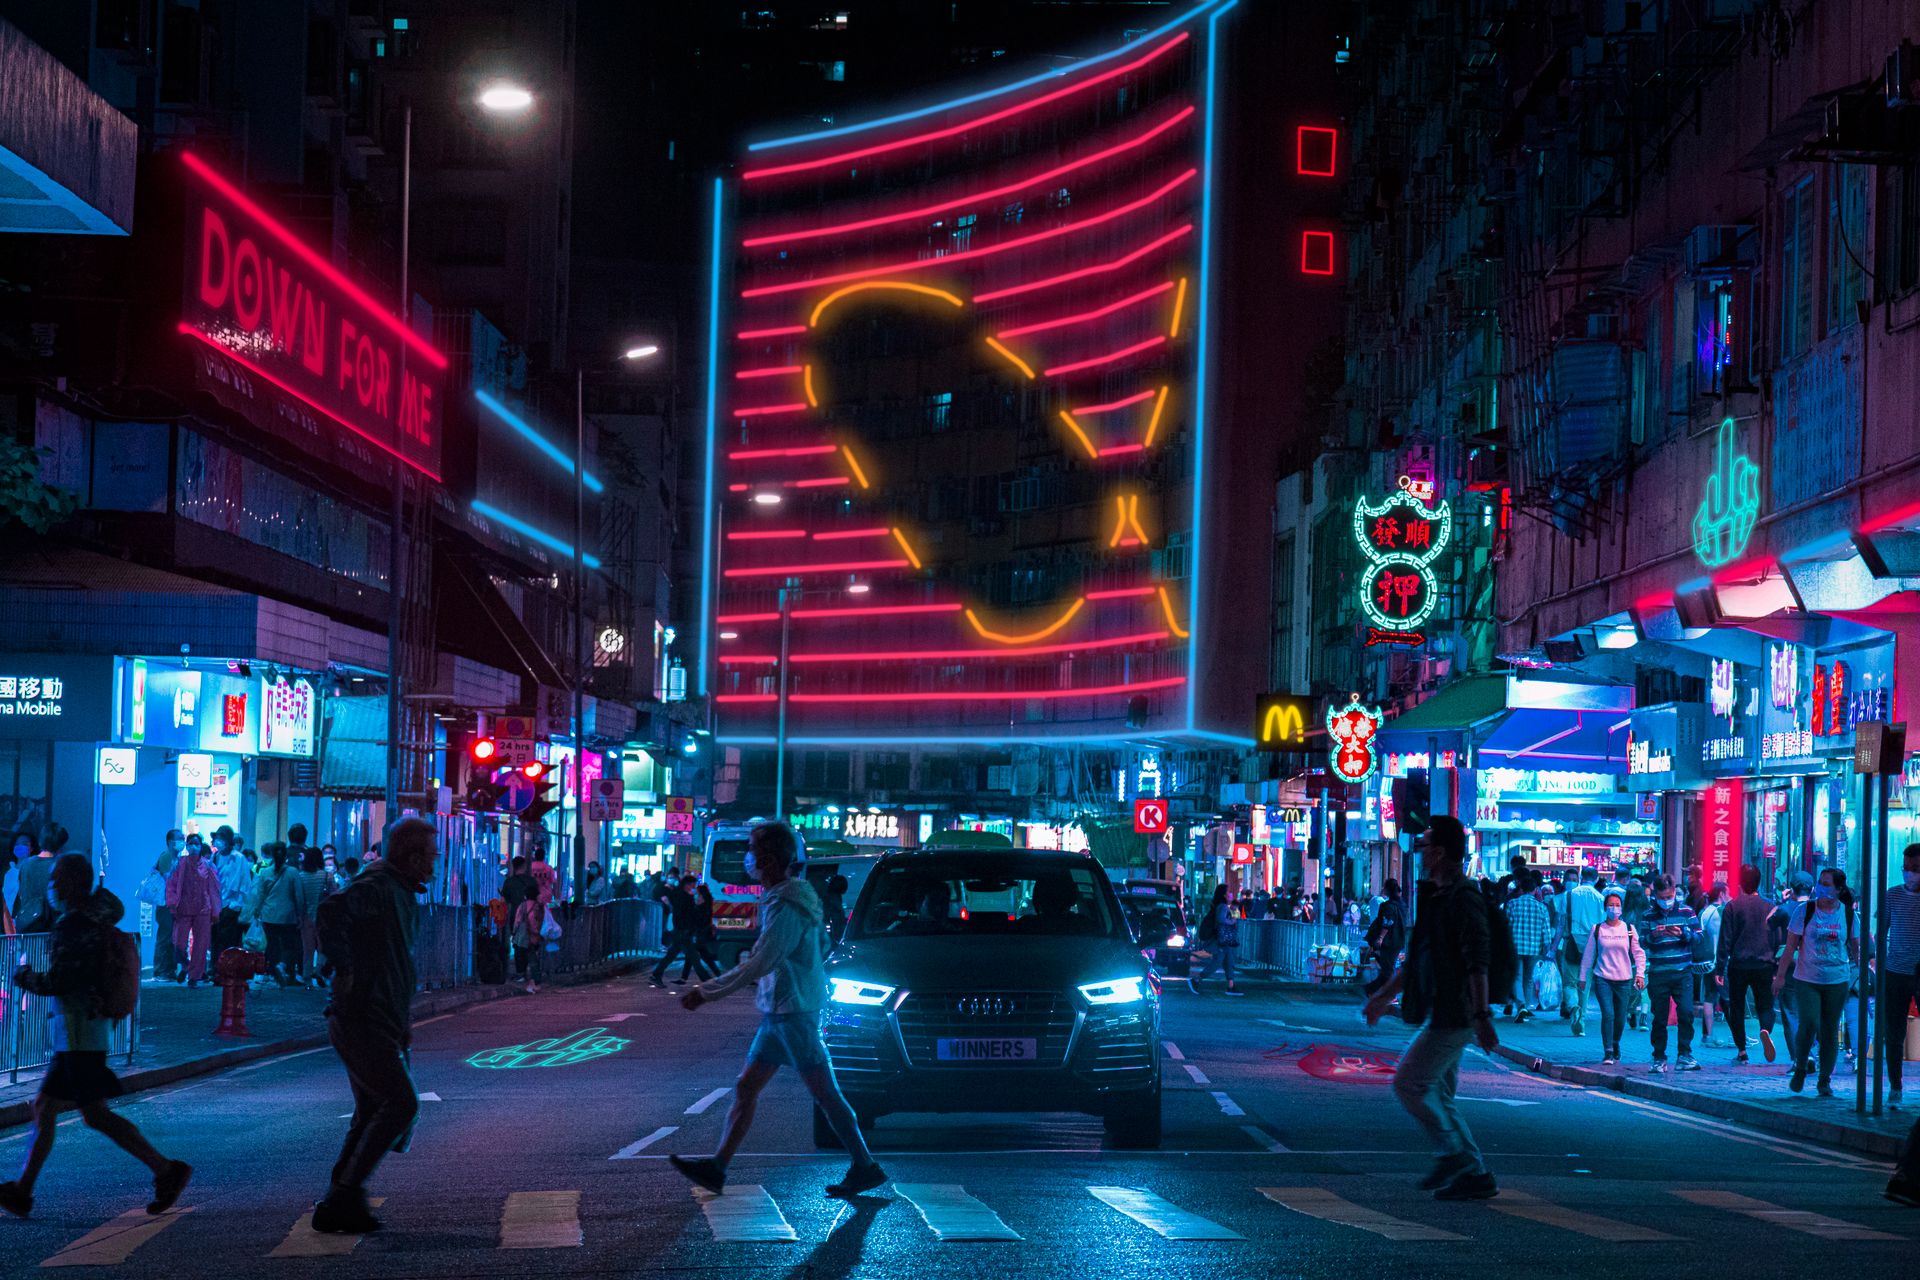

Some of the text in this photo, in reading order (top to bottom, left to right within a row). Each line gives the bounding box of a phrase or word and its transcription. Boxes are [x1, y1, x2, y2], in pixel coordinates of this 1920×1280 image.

[201, 207, 433, 447] DOWN FOR ME
[1377, 570, 1420, 616] 押
[0, 677, 63, 699] 國移動
[17, 701, 62, 716] Mobile
[500, 742, 530, 751] 24 hrs
[948, 1041, 1025, 1058] WINNERS
